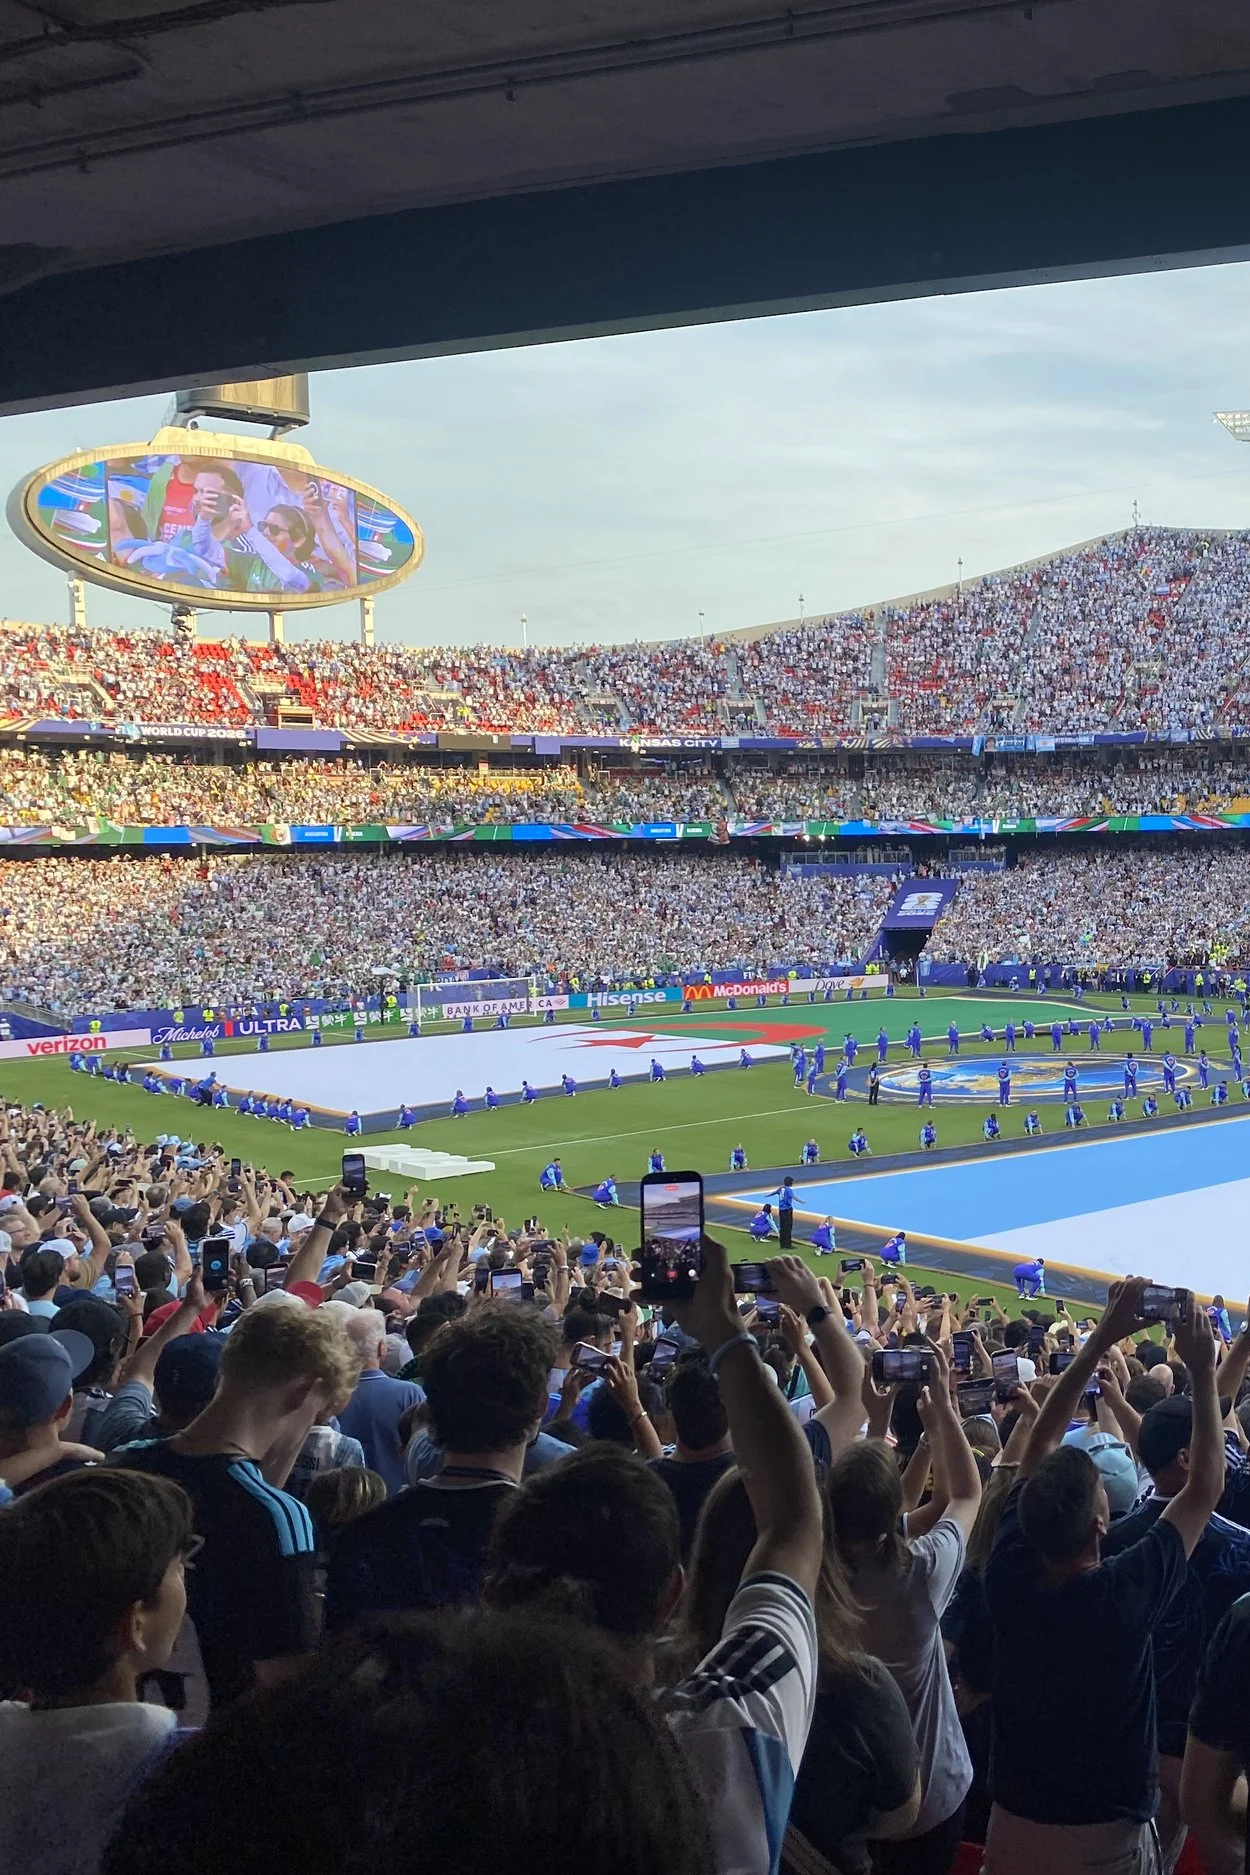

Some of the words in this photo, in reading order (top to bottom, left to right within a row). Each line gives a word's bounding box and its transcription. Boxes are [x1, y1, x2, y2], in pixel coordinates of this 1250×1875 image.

[140, 726, 183, 737] WORLD
[183, 727, 207, 737] CUP
[207, 729, 247, 739] 2026
[684, 739, 719, 748] CITY
[713, 982, 787, 998] McDonald's
[814, 977, 845, 992] Dove
[447, 1004, 480, 1015] BANK
[482, 1003, 498, 1012] OF
[500, 999, 553, 1013] AMERCA
[587, 991, 667, 1007] Hisense
[152, 1024, 220, 1045] Michelob
[239, 1017, 302, 1035] ULTRA
[27, 1035, 107, 1055] verizon
